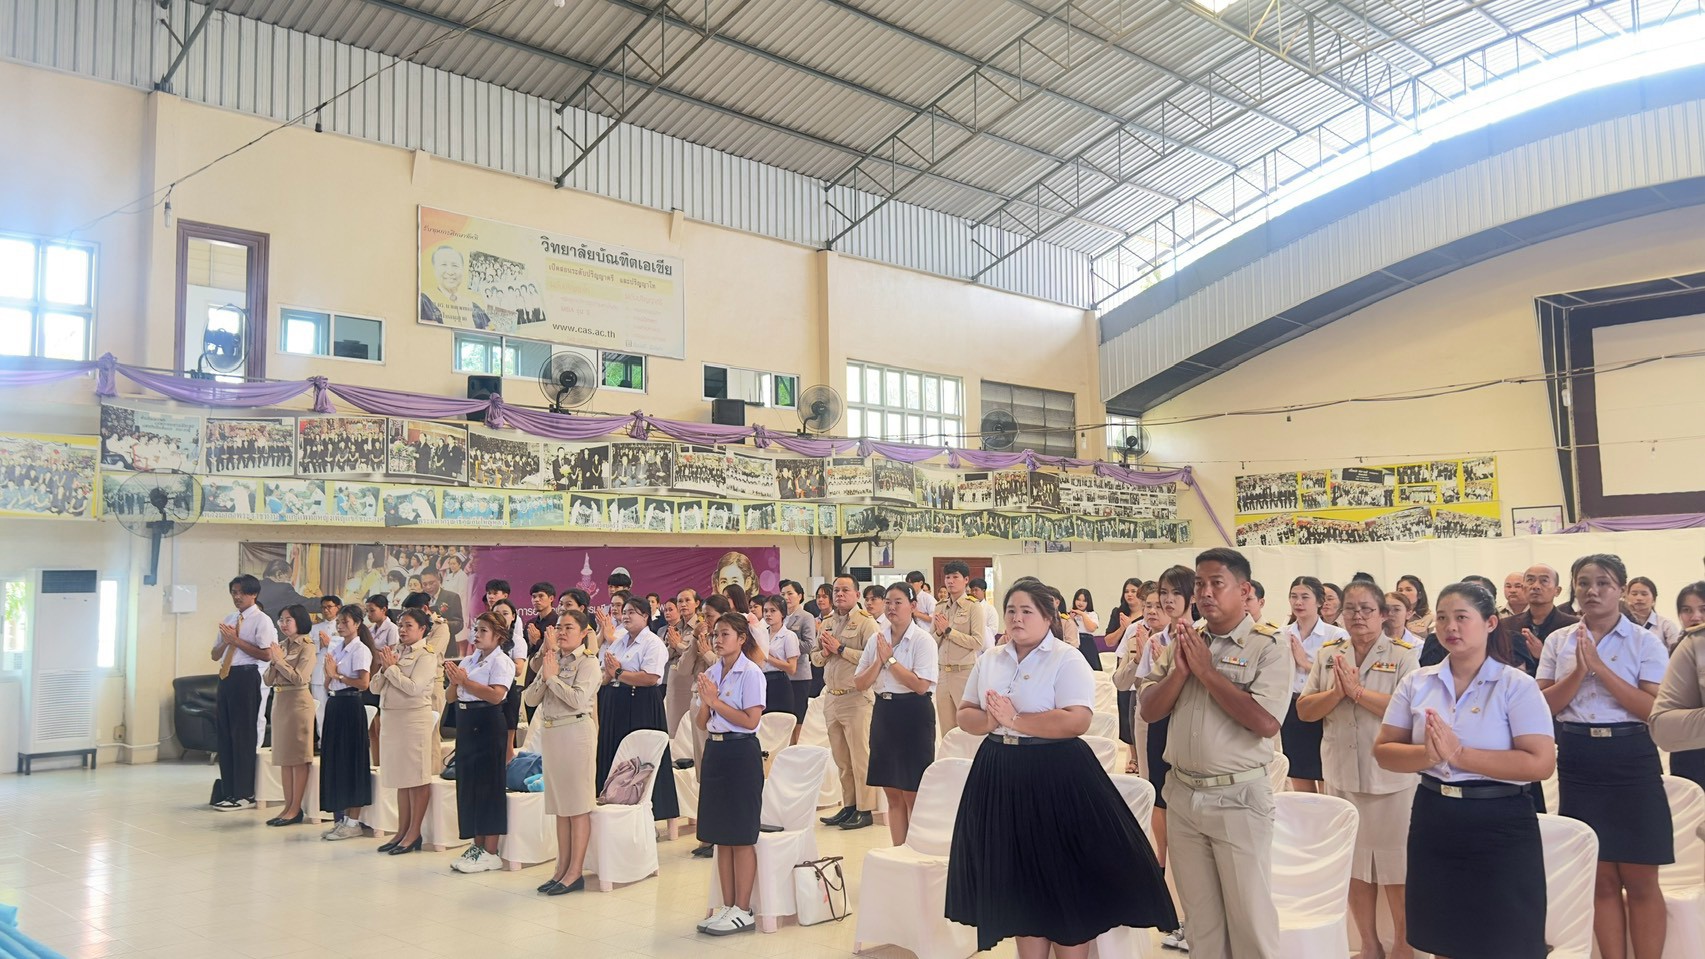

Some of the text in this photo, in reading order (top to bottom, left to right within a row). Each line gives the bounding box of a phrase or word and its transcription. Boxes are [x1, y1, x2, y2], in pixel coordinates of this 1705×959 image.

[540, 235, 673, 276] วิทยาลัยบัณฑิตเอเชีย
[548, 262, 614, 282] เปิดสอนระดับปริญญาตรี
[552, 323, 616, 339] www.cas.ac.th
